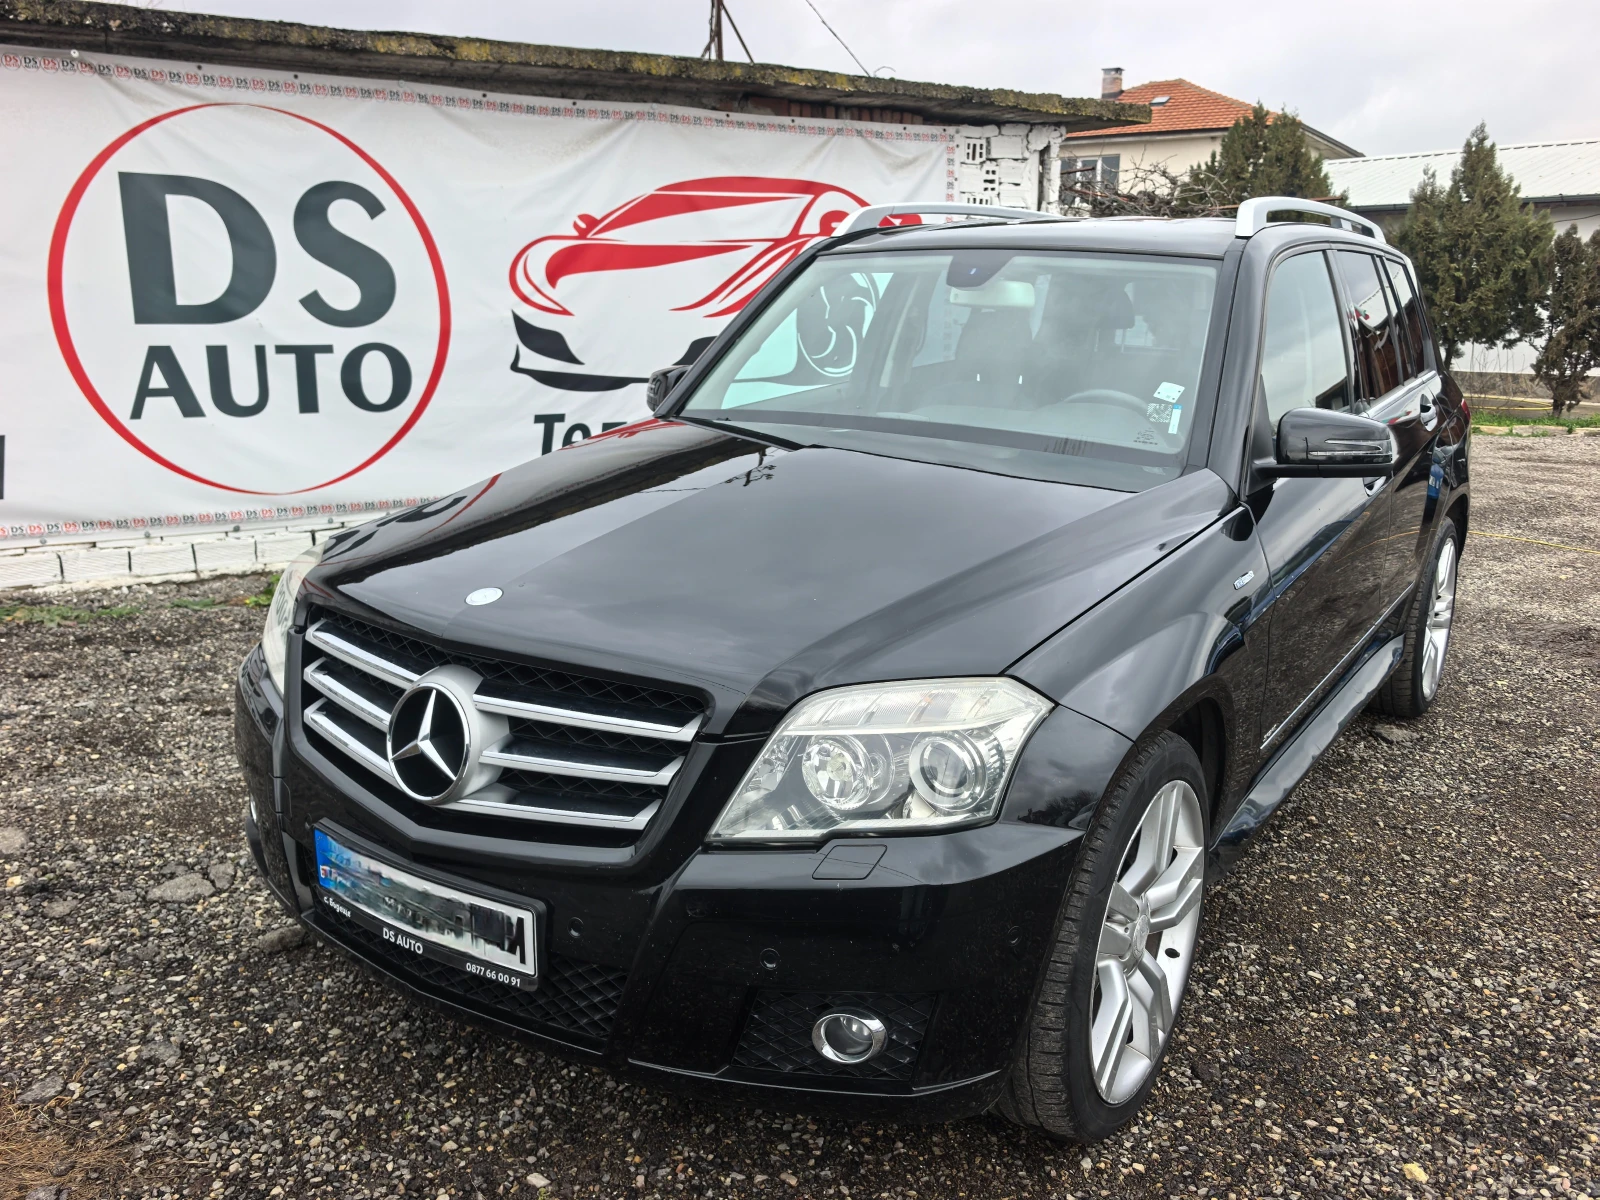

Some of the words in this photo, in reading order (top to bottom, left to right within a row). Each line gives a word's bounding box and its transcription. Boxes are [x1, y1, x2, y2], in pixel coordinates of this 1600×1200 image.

[118, 171, 397, 328] DS
[130, 342, 412, 420] AUTO
[382, 928, 395, 942] DS
[396, 934, 423, 954] AUTO
[466, 962, 484, 976] 0877
[486, 970, 496, 980] 66
[498, 972, 510, 984] 00
[511, 977, 520, 988] 91
